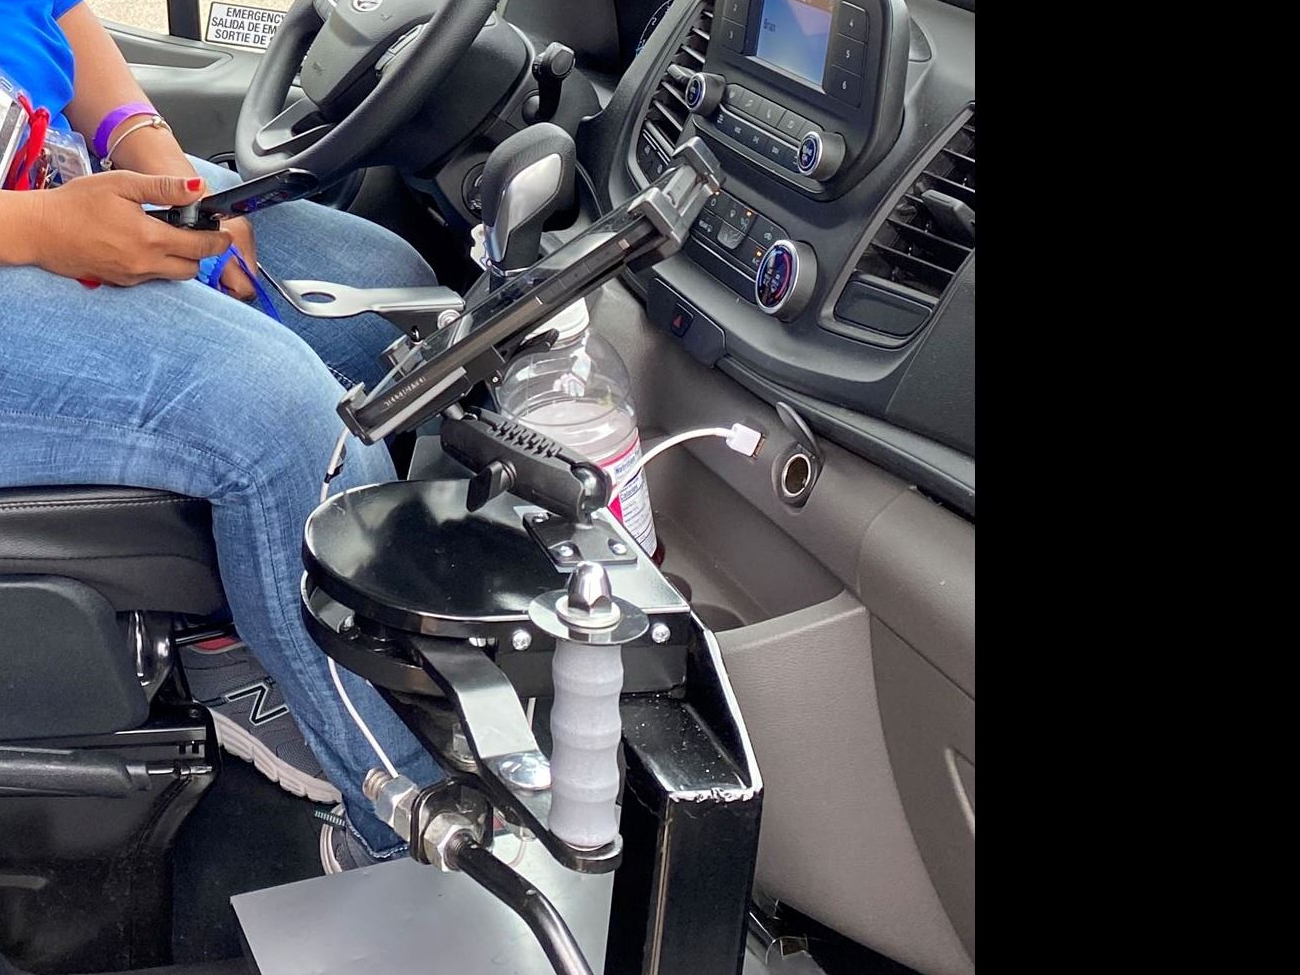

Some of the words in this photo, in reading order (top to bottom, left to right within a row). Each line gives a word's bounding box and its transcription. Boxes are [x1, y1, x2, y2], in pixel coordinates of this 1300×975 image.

[211, 16, 245, 31] SALIDA
[247, 21, 260, 33] DE
[848, 18, 854, 28] 4
[214, 28, 251, 43] SORTIE
[253, 34, 267, 45] DE
[845, 49, 851, 59] 5
[841, 80, 847, 90] 6
